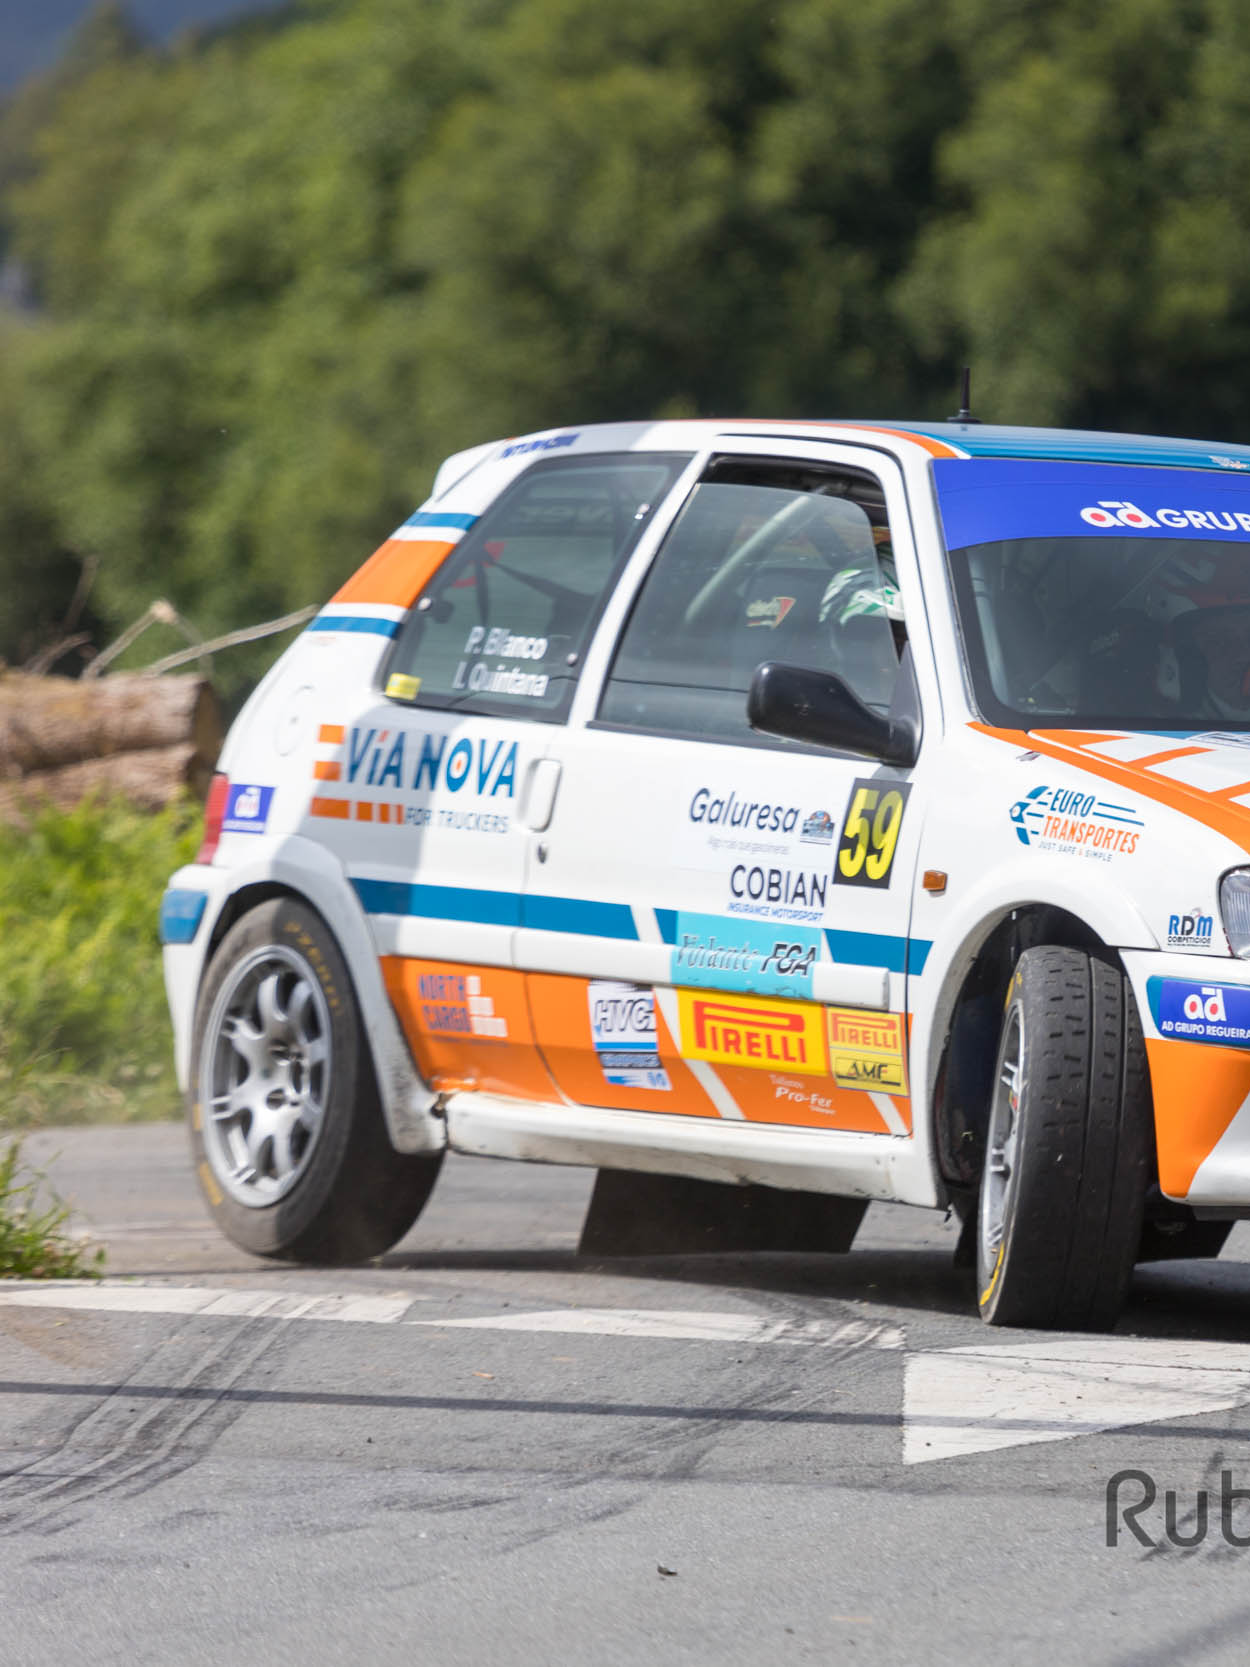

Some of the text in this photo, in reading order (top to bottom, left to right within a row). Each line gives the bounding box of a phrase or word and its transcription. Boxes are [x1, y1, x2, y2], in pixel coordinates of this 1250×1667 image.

[483, 628, 548, 660] Blanco
[413, 733, 519, 798] NOVA
[406, 807, 509, 833] FOR TRUCKERS
[688, 787, 800, 833] Galuresa
[1050, 788, 1096, 817] EURO
[839, 788, 903, 881] 59
[1043, 815, 1140, 854] TRANSPORTES
[730, 864, 828, 908] COBIAN
[727, 902, 824, 922] INSURANCE MOTORSPORT
[677, 935, 760, 971] Volante
[419, 975, 466, 1002] NORTH
[422, 1005, 470, 1032] CARGO
[693, 1000, 807, 1063] PIRELLI
[832, 1013, 897, 1049] PIRELLI
[1161, 1021, 1174, 1031] AD
[1175, 1022, 1205, 1034] GRUPO
